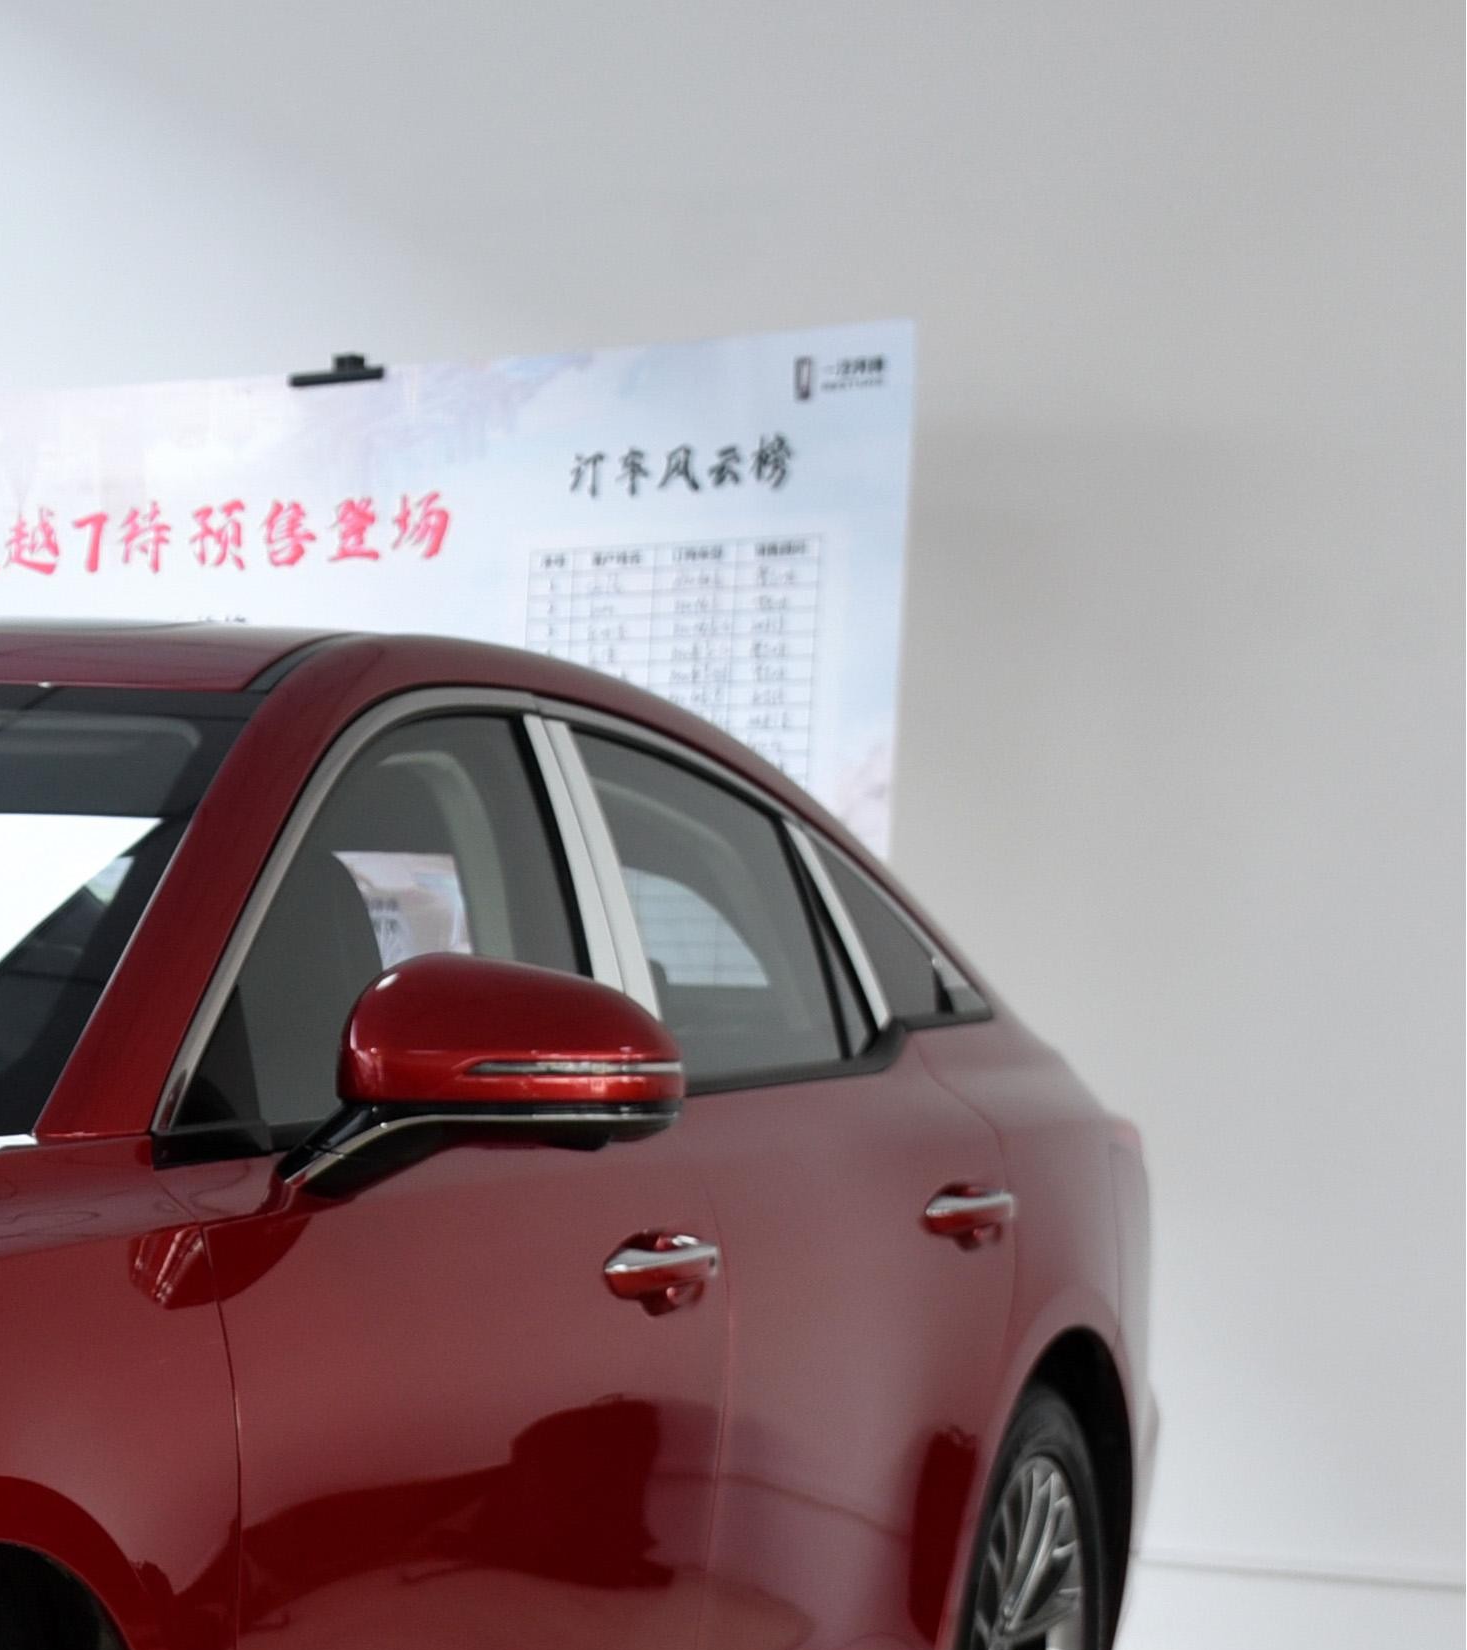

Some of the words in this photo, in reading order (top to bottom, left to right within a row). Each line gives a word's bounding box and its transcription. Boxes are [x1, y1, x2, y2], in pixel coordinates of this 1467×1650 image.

[570, 432, 793, 498] 订车风云榜
